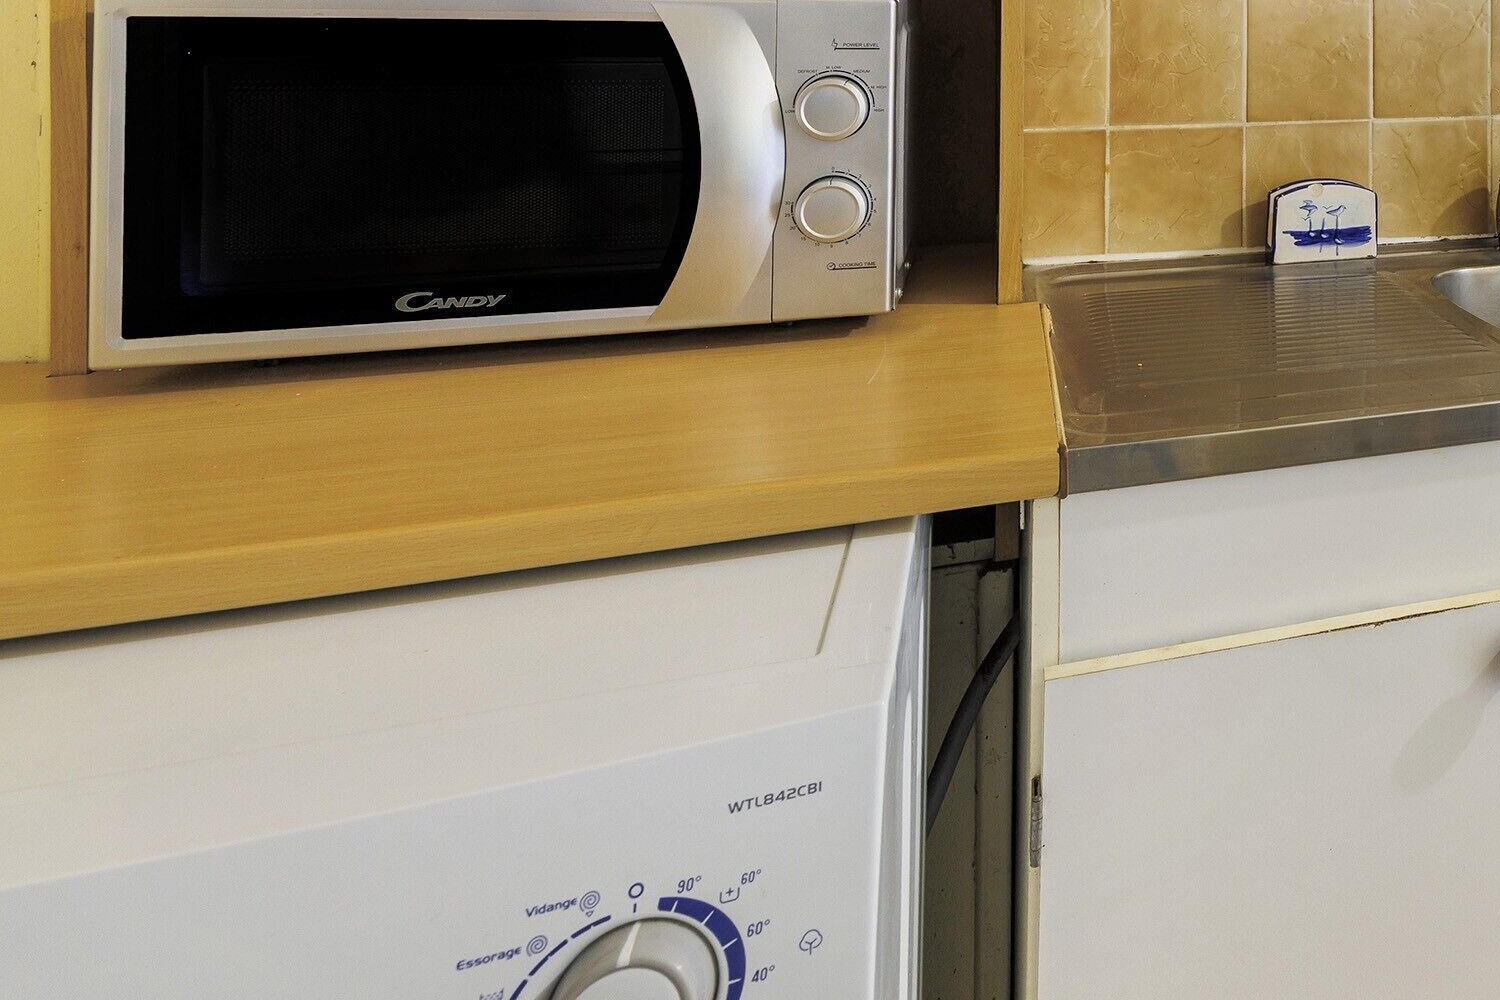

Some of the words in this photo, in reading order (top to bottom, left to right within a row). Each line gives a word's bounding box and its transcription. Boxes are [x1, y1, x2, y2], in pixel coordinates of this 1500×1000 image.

[395, 291, 506, 313] CANDY
[677, 875, 702, 894] 90°
[740, 868, 762, 885] 60°
[525, 897, 578, 918] Vidange
[746, 918, 771, 938] 60°
[456, 946, 522, 971] Essorage
[751, 964, 776, 983] 40°
